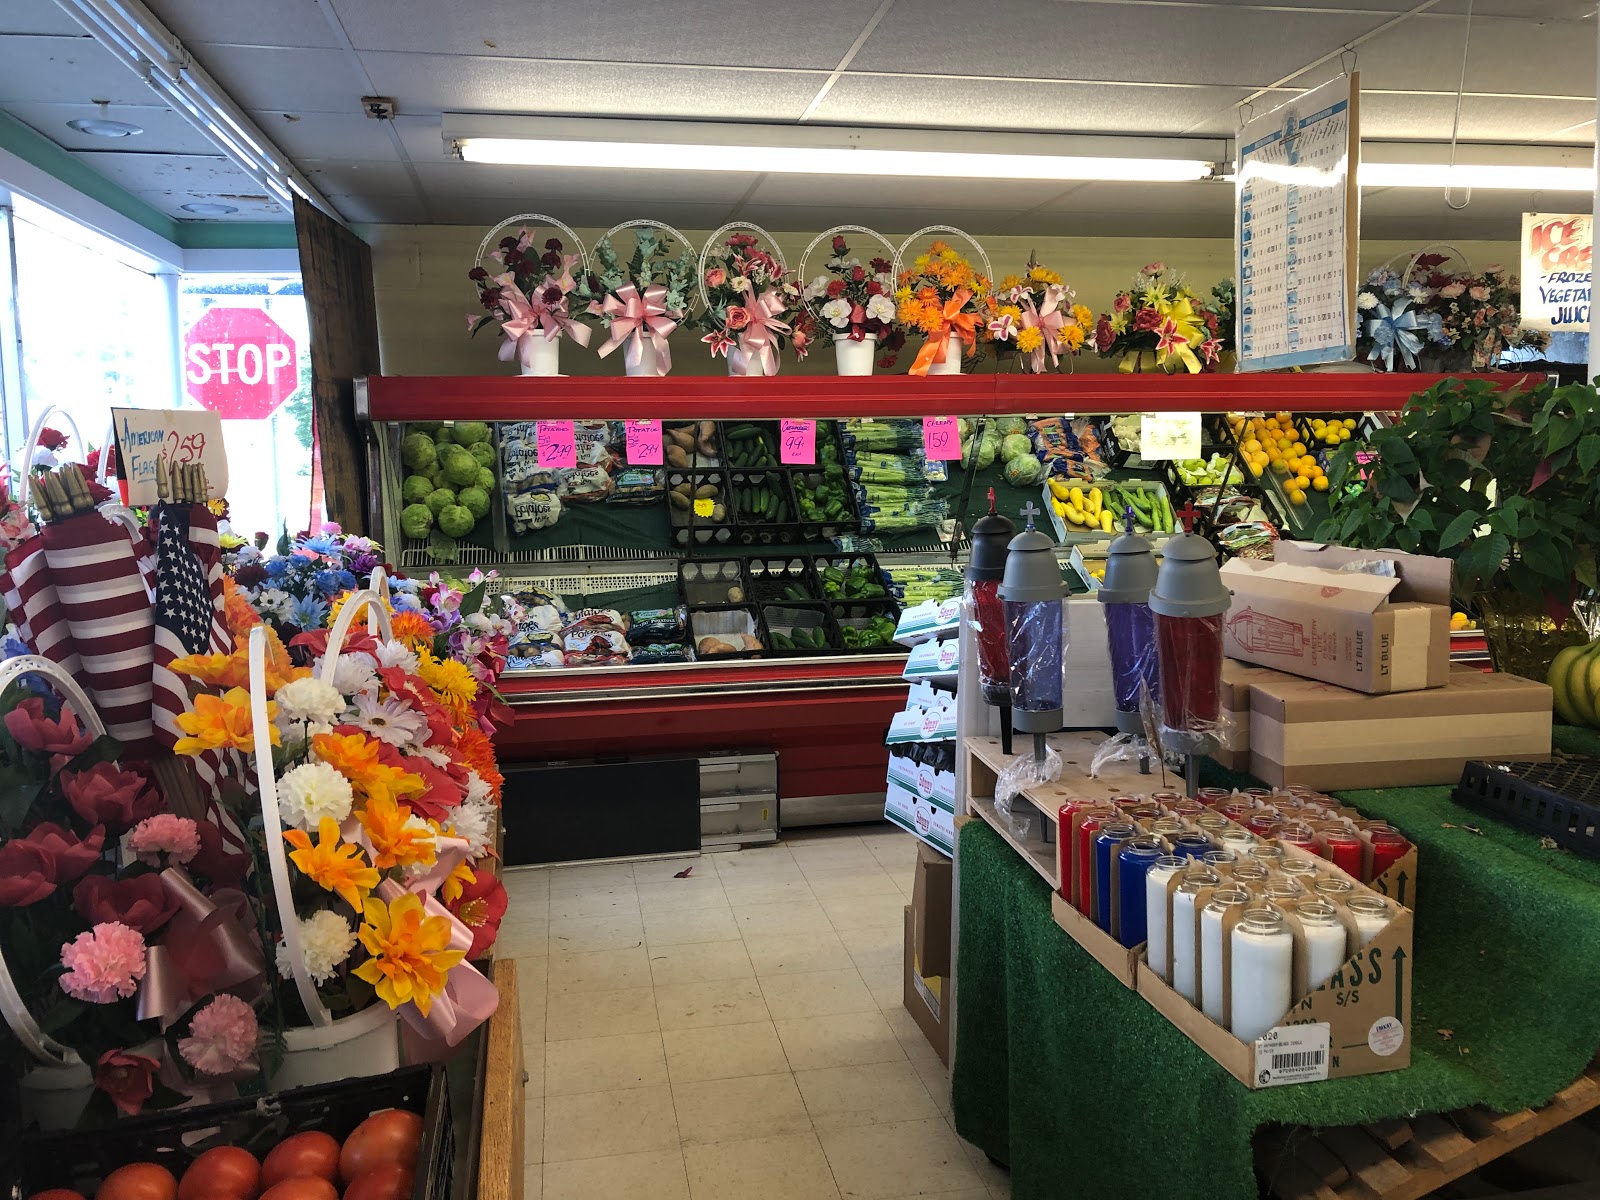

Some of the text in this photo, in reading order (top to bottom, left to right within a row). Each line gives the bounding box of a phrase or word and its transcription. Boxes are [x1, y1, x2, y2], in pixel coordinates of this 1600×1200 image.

[1529, 217, 1582, 255] ICE
[186, 342, 291, 385] STOP
[121, 417, 164, 453] AMERICAN
[1356, 660, 1363, 672] LT
[1381, 664, 1388, 676] LT
[1336, 990, 1360, 1008] S/S
